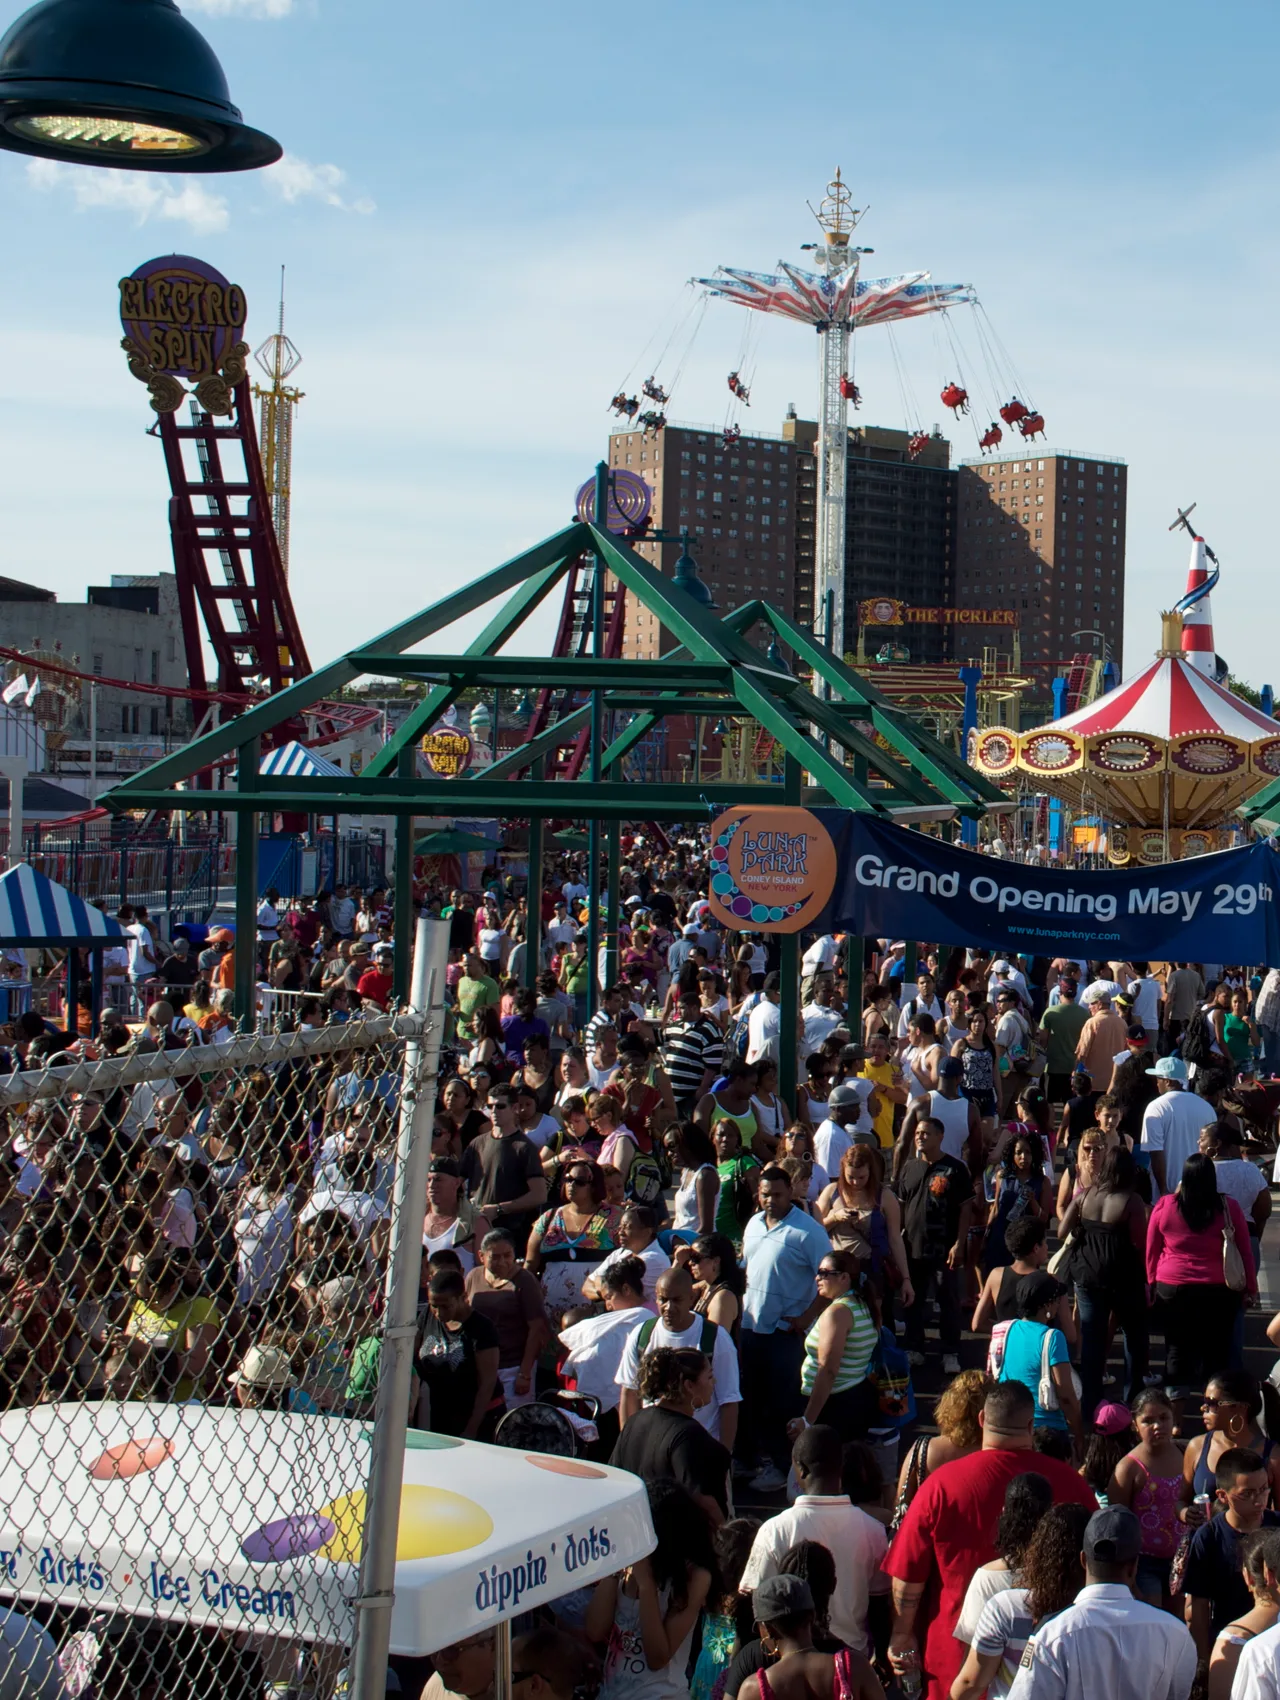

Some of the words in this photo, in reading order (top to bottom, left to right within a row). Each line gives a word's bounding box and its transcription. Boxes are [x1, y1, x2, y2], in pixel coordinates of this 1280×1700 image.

[119, 277, 247, 328] ELECTRO
[150, 327, 214, 376] SPIN
[905, 608, 938, 623] THE
[944, 609, 1016, 625] TICKLER
[742, 831, 808, 852] LUNA
[740, 850, 809, 875] PARK
[740, 874, 771, 884] CONEY
[772, 875, 805, 885] ISLAND
[748, 883, 770, 891] NEW
[773, 884, 798, 893] YORK
[855, 854, 959, 898] Grand
[969, 876, 1117, 922] Opening
[1128, 886, 1203, 922] May
[1211, 882, 1273, 915] 29th
[1007, 924, 1121, 941] www.lunaparknyc.com
[564, 1525, 611, 1573] dots
[40, 1546, 104, 1591] dots
[151, 1561, 191, 1603] Ice
[201, 1568, 296, 1618] Cream
